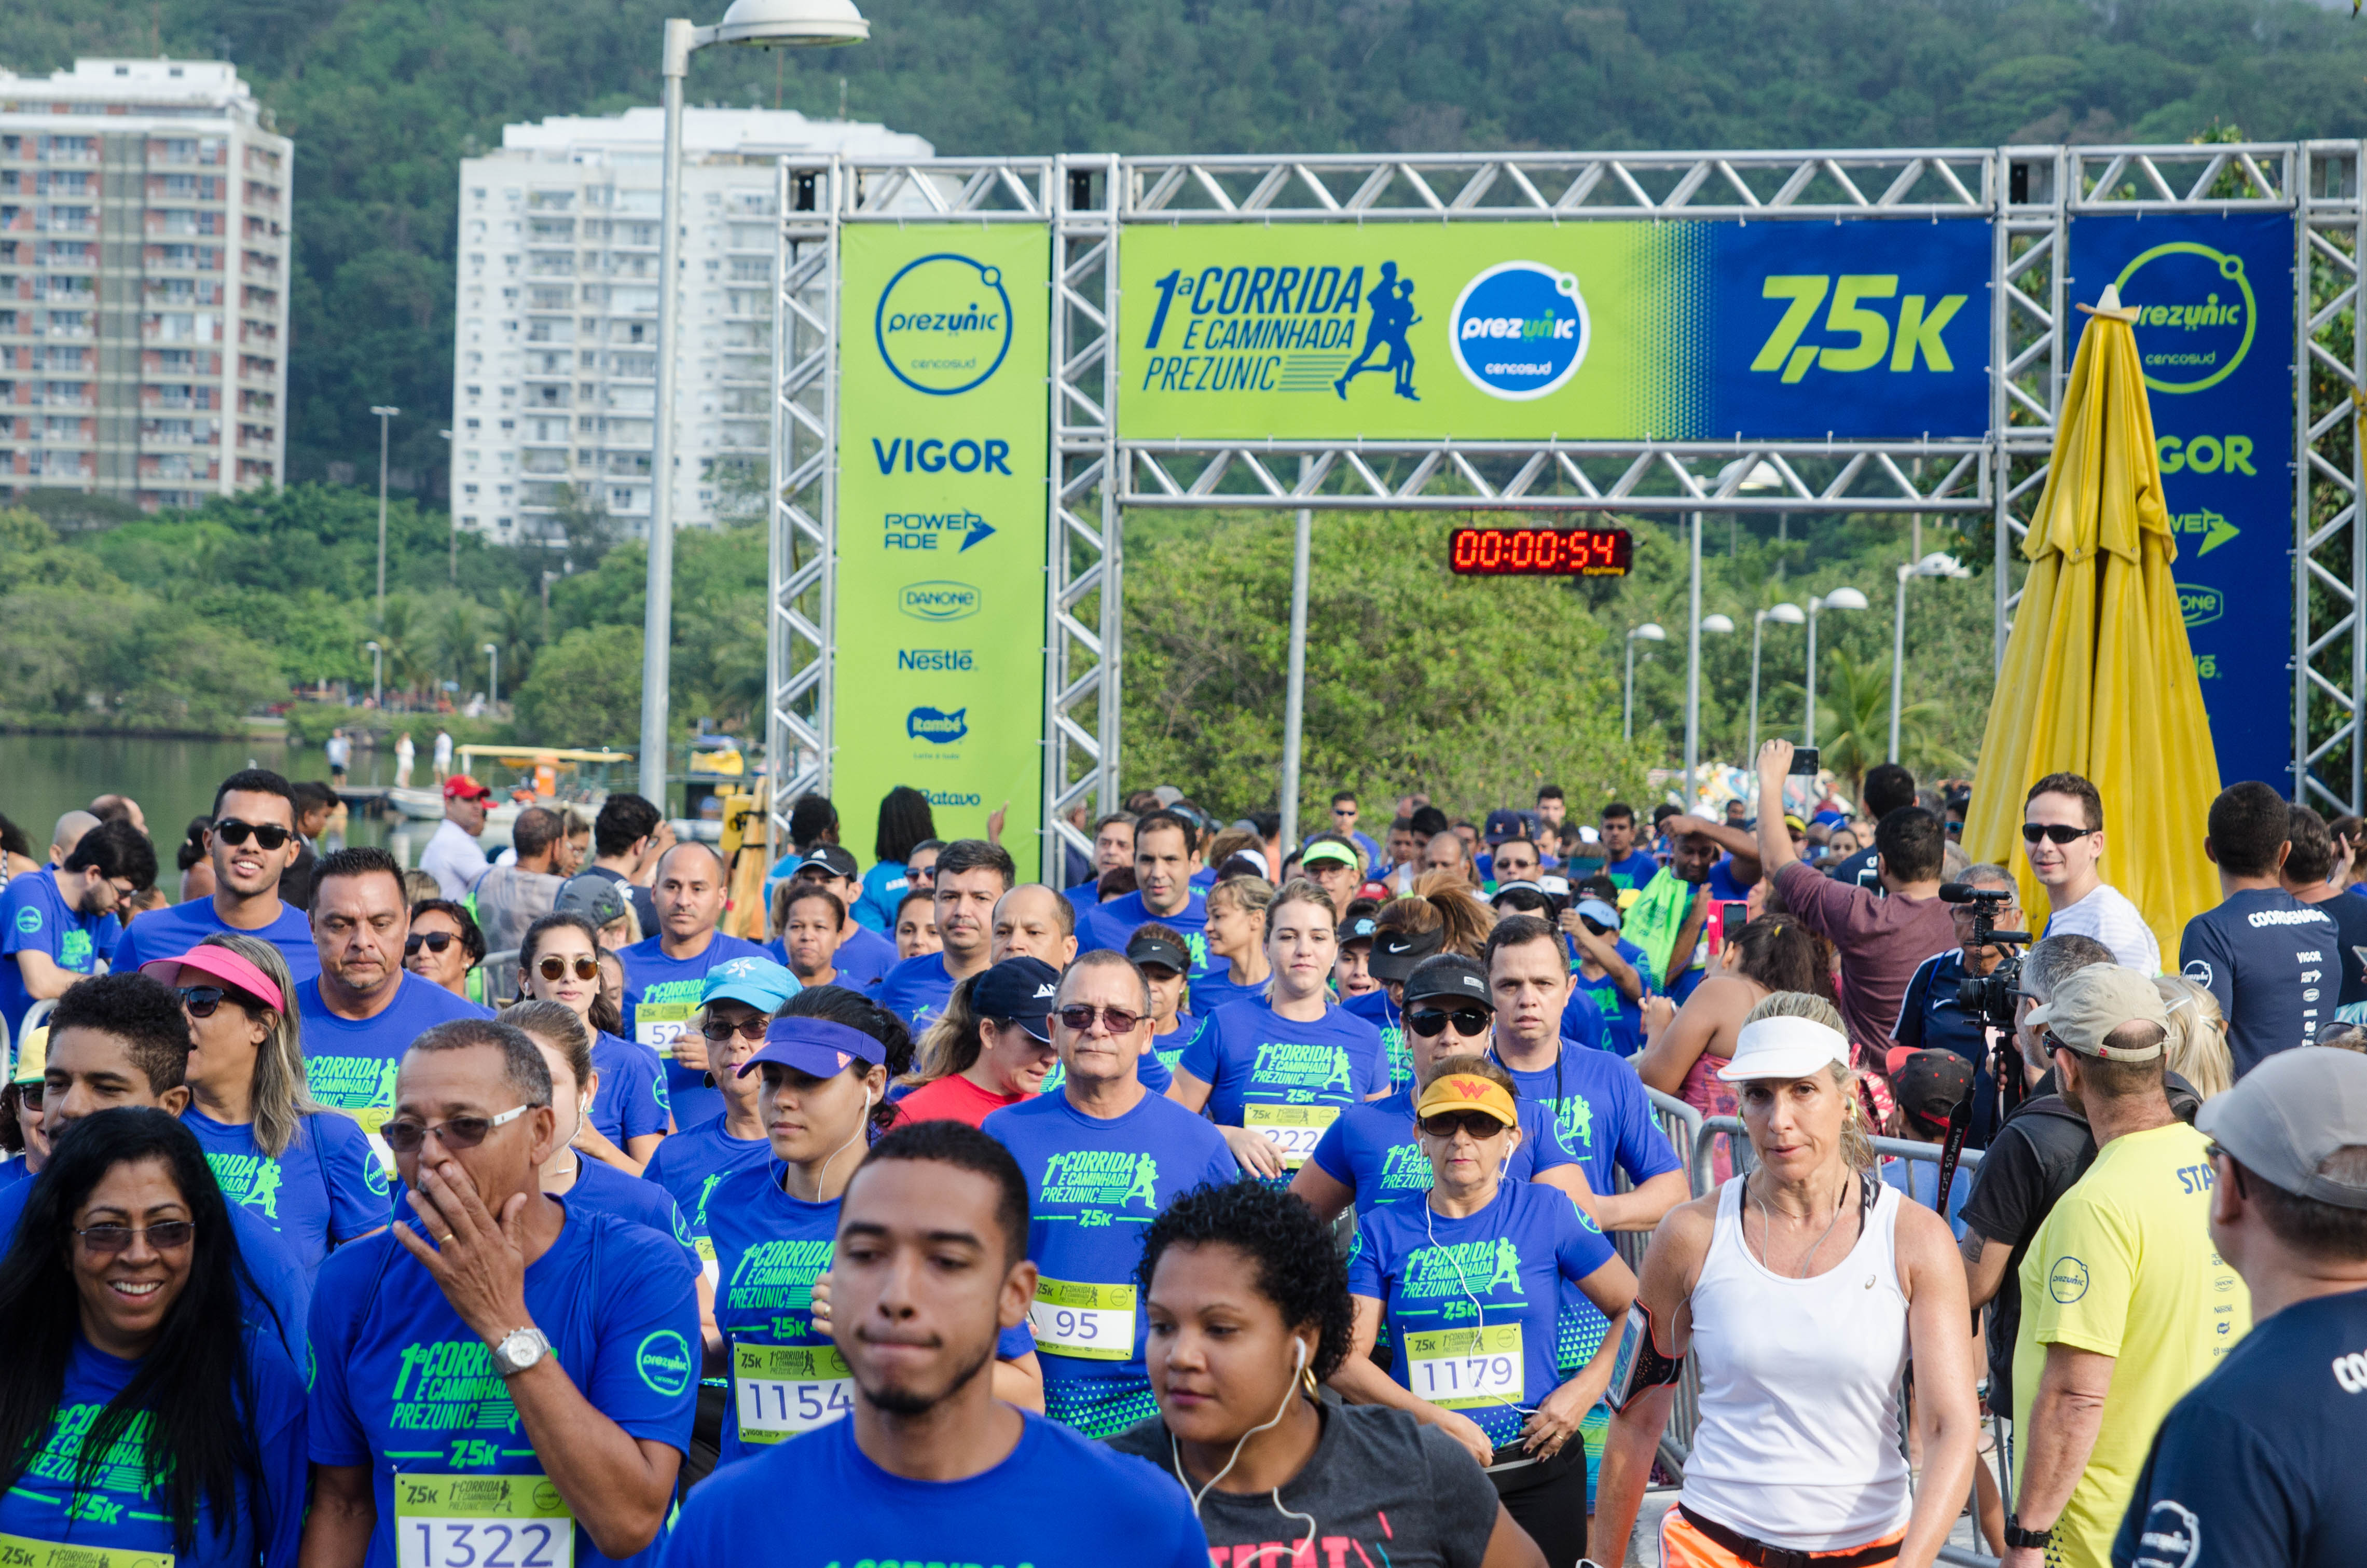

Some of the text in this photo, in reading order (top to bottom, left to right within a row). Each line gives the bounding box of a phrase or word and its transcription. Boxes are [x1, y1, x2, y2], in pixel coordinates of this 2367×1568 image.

[1191, 266, 1364, 314] CORRIDA
[888, 303, 998, 335] prezunic
[2130, 293, 2240, 331] rezunic
[1183, 319, 1351, 349] E CAMINHADA
[1461, 309, 1576, 341] prezunic
[912, 357, 975, 369] cencosud
[1485, 361, 1551, 375] cencosud
[2145, 351, 2215, 365] cencosud
[1143, 356, 1281, 391] PREZUNIC
[872, 438, 1012, 475] VIGOR
[2157, 435, 2257, 476] GOR
[885, 513, 983, 530] POWER
[1455, 530, 1614, 568] 00:00:54
[2296, 951, 2322, 964] VIGOR
[1270, 1043, 1333, 1063] CORRIDA
[310, 1055, 382, 1080] CORRIDA
[1267, 1060, 1330, 1074] E CAMINHADA
[311, 1078, 376, 1094] CAMINHADA
[1251, 1070, 1305, 1085] PREZUNIC
[1062, 1151, 1136, 1172] CORRIDA
[1057, 1172, 1132, 1186] E CAMINHADA
[2178, 1163, 2215, 1194] STA
[1039, 1187, 1100, 1203] PREZUNIC
[1079, 1209, 1113, 1228] 7,5K
[753, 1240, 836, 1267] CORRIDA
[1422, 1240, 1495, 1267] CORRIDA
[744, 1268, 757, 1286] E
[1418, 1267, 1429, 1281] E
[727, 1287, 788, 1309] PREZUNIC
[1401, 1279, 1462, 1298] PREZUNIC
[1056, 1311, 1098, 1339] 95
[776, 1351, 804, 1360] CORRIDA
[1415, 1339, 1436, 1352] 7,5K
[741, 1353, 762, 1369] 7,5K
[1423, 1357, 1512, 1391] 1179
[414, 1378, 511, 1400] E CAMINHAD
[749, 1383, 855, 1420] 1154
[390, 1402, 477, 1429] PREZUNIC
[449, 1440, 499, 1469] 7,5K
[407, 1486, 438, 1505] 7,5K
[459, 1481, 499, 1492] CORRIDA
[448, 1502, 479, 1511] PREZUNIC
[58, 1549, 99, 1562] CORRIDA
[417, 1523, 553, 1568] 1322
